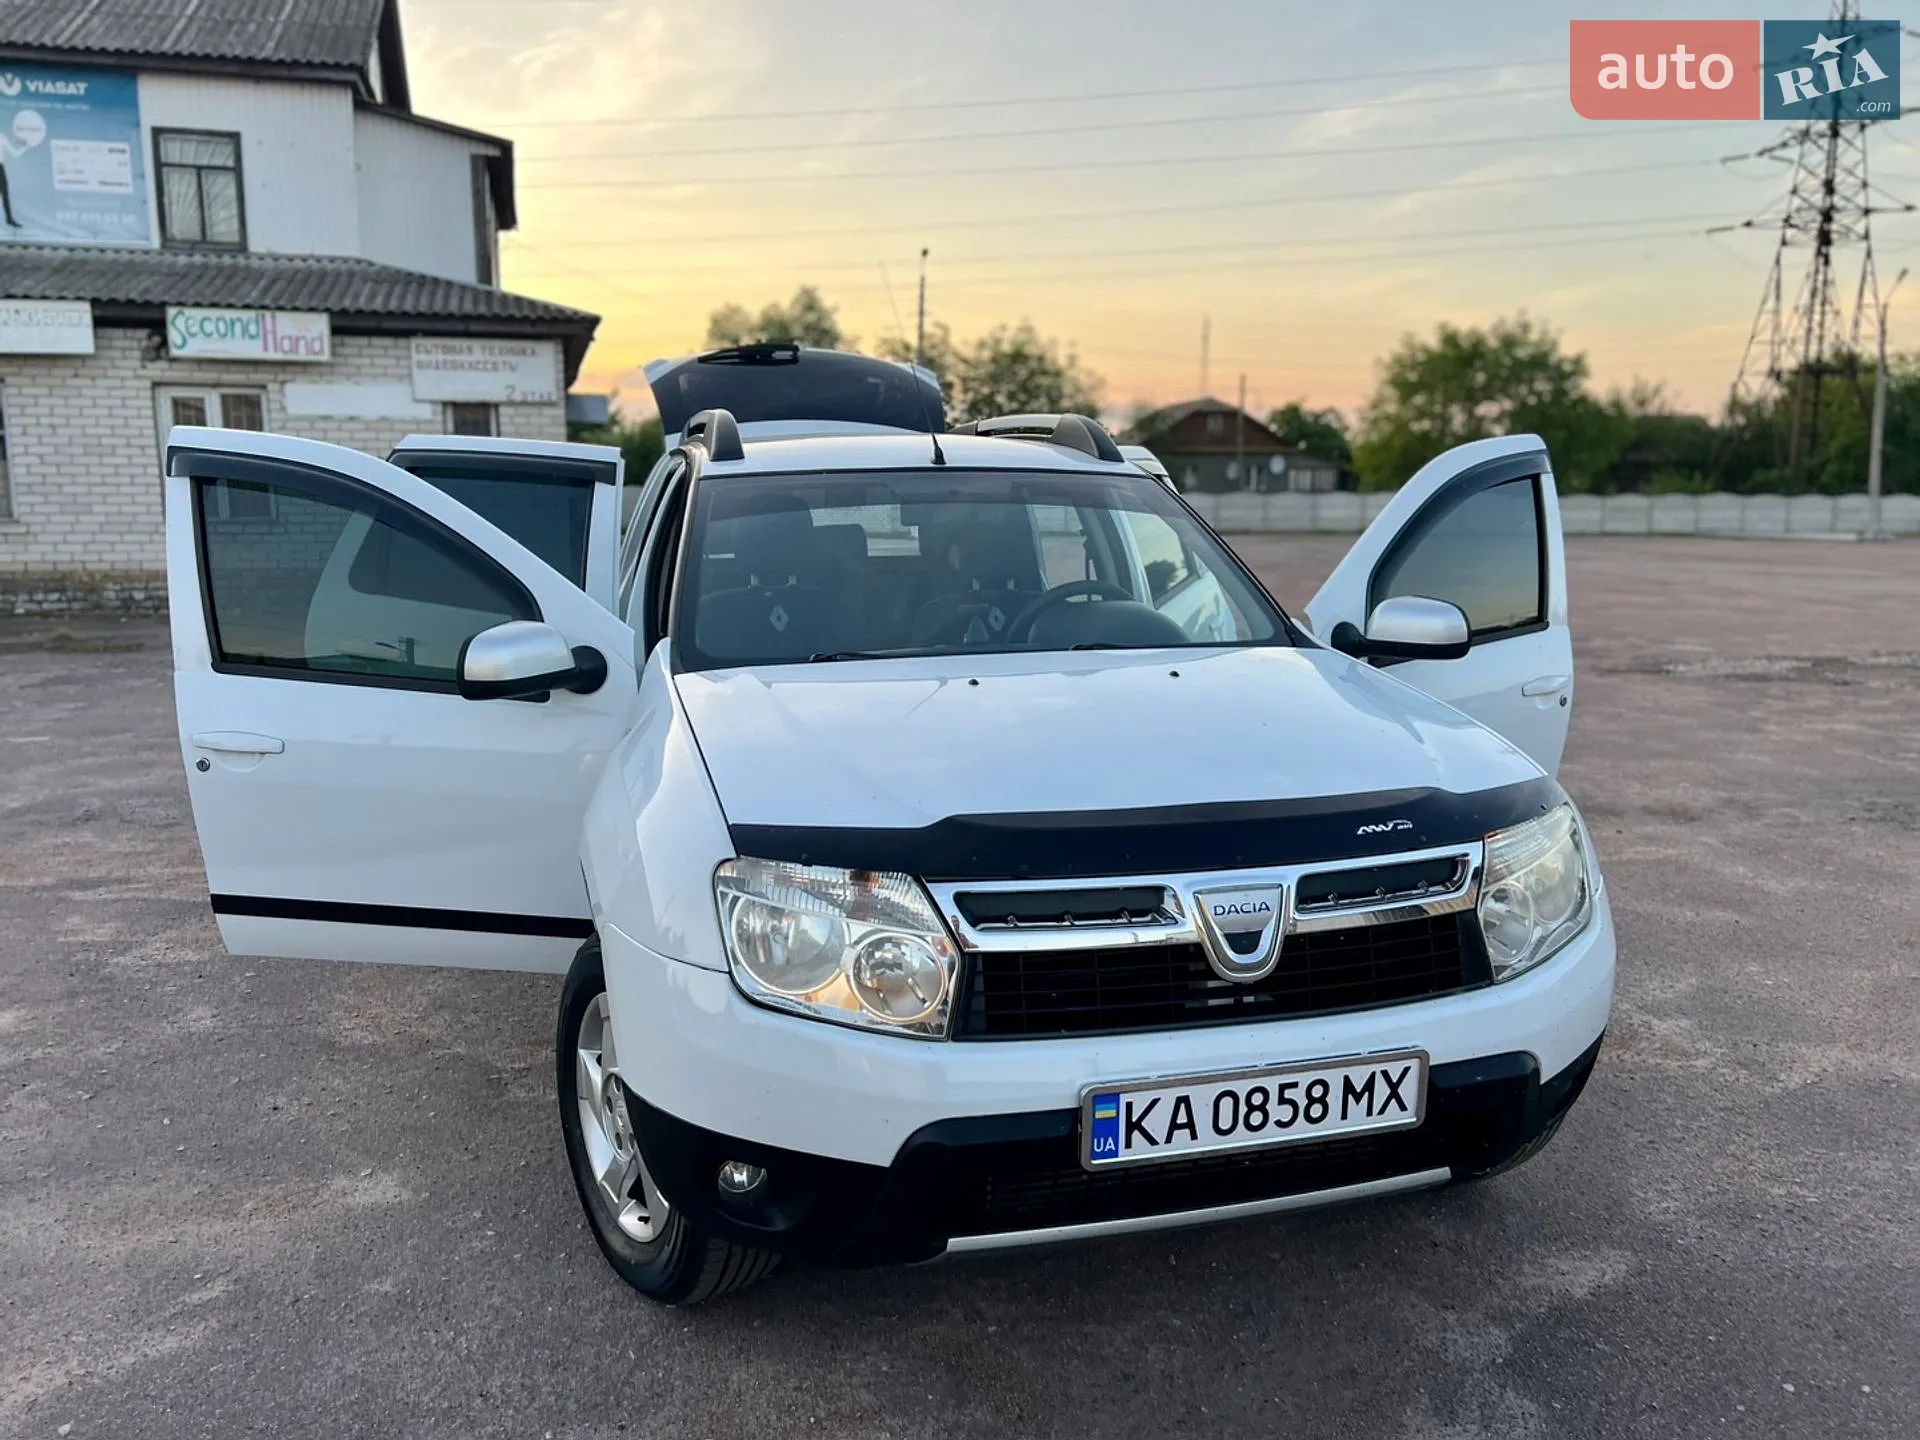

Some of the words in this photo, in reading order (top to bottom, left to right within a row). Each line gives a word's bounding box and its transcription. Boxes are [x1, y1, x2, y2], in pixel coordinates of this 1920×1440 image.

[26, 80, 88, 95] VIASAT
[170, 310, 260, 350] Second
[261, 312, 325, 356] Hand
[504, 384, 517, 401] 2
[1214, 901, 1271, 917] DACIA
[1123, 1094, 1199, 1150] KA
[1212, 1078, 1331, 1137] 0858
[1341, 1065, 1412, 1121] MX
[1093, 1137, 1116, 1153] UA
